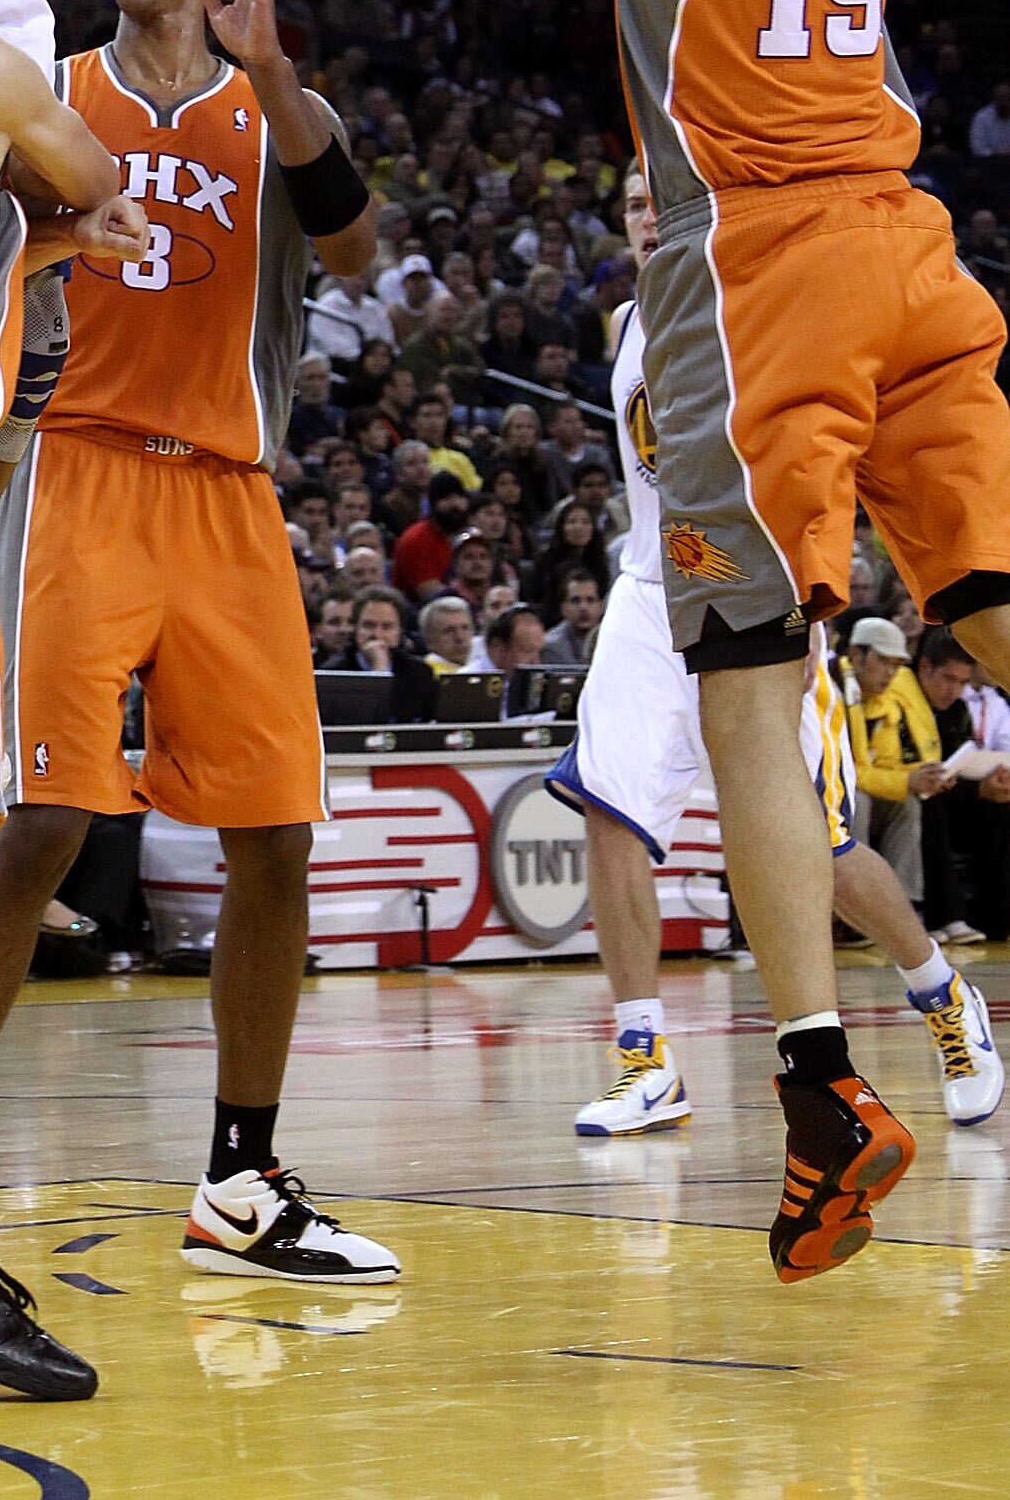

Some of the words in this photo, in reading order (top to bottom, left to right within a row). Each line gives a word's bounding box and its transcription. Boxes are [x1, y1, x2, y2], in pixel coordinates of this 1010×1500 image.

[109, 151, 239, 233] HX
[54, 316, 63, 332] 8
[144, 436, 195, 455] SUNS
[508, 839, 587, 886] TNT
